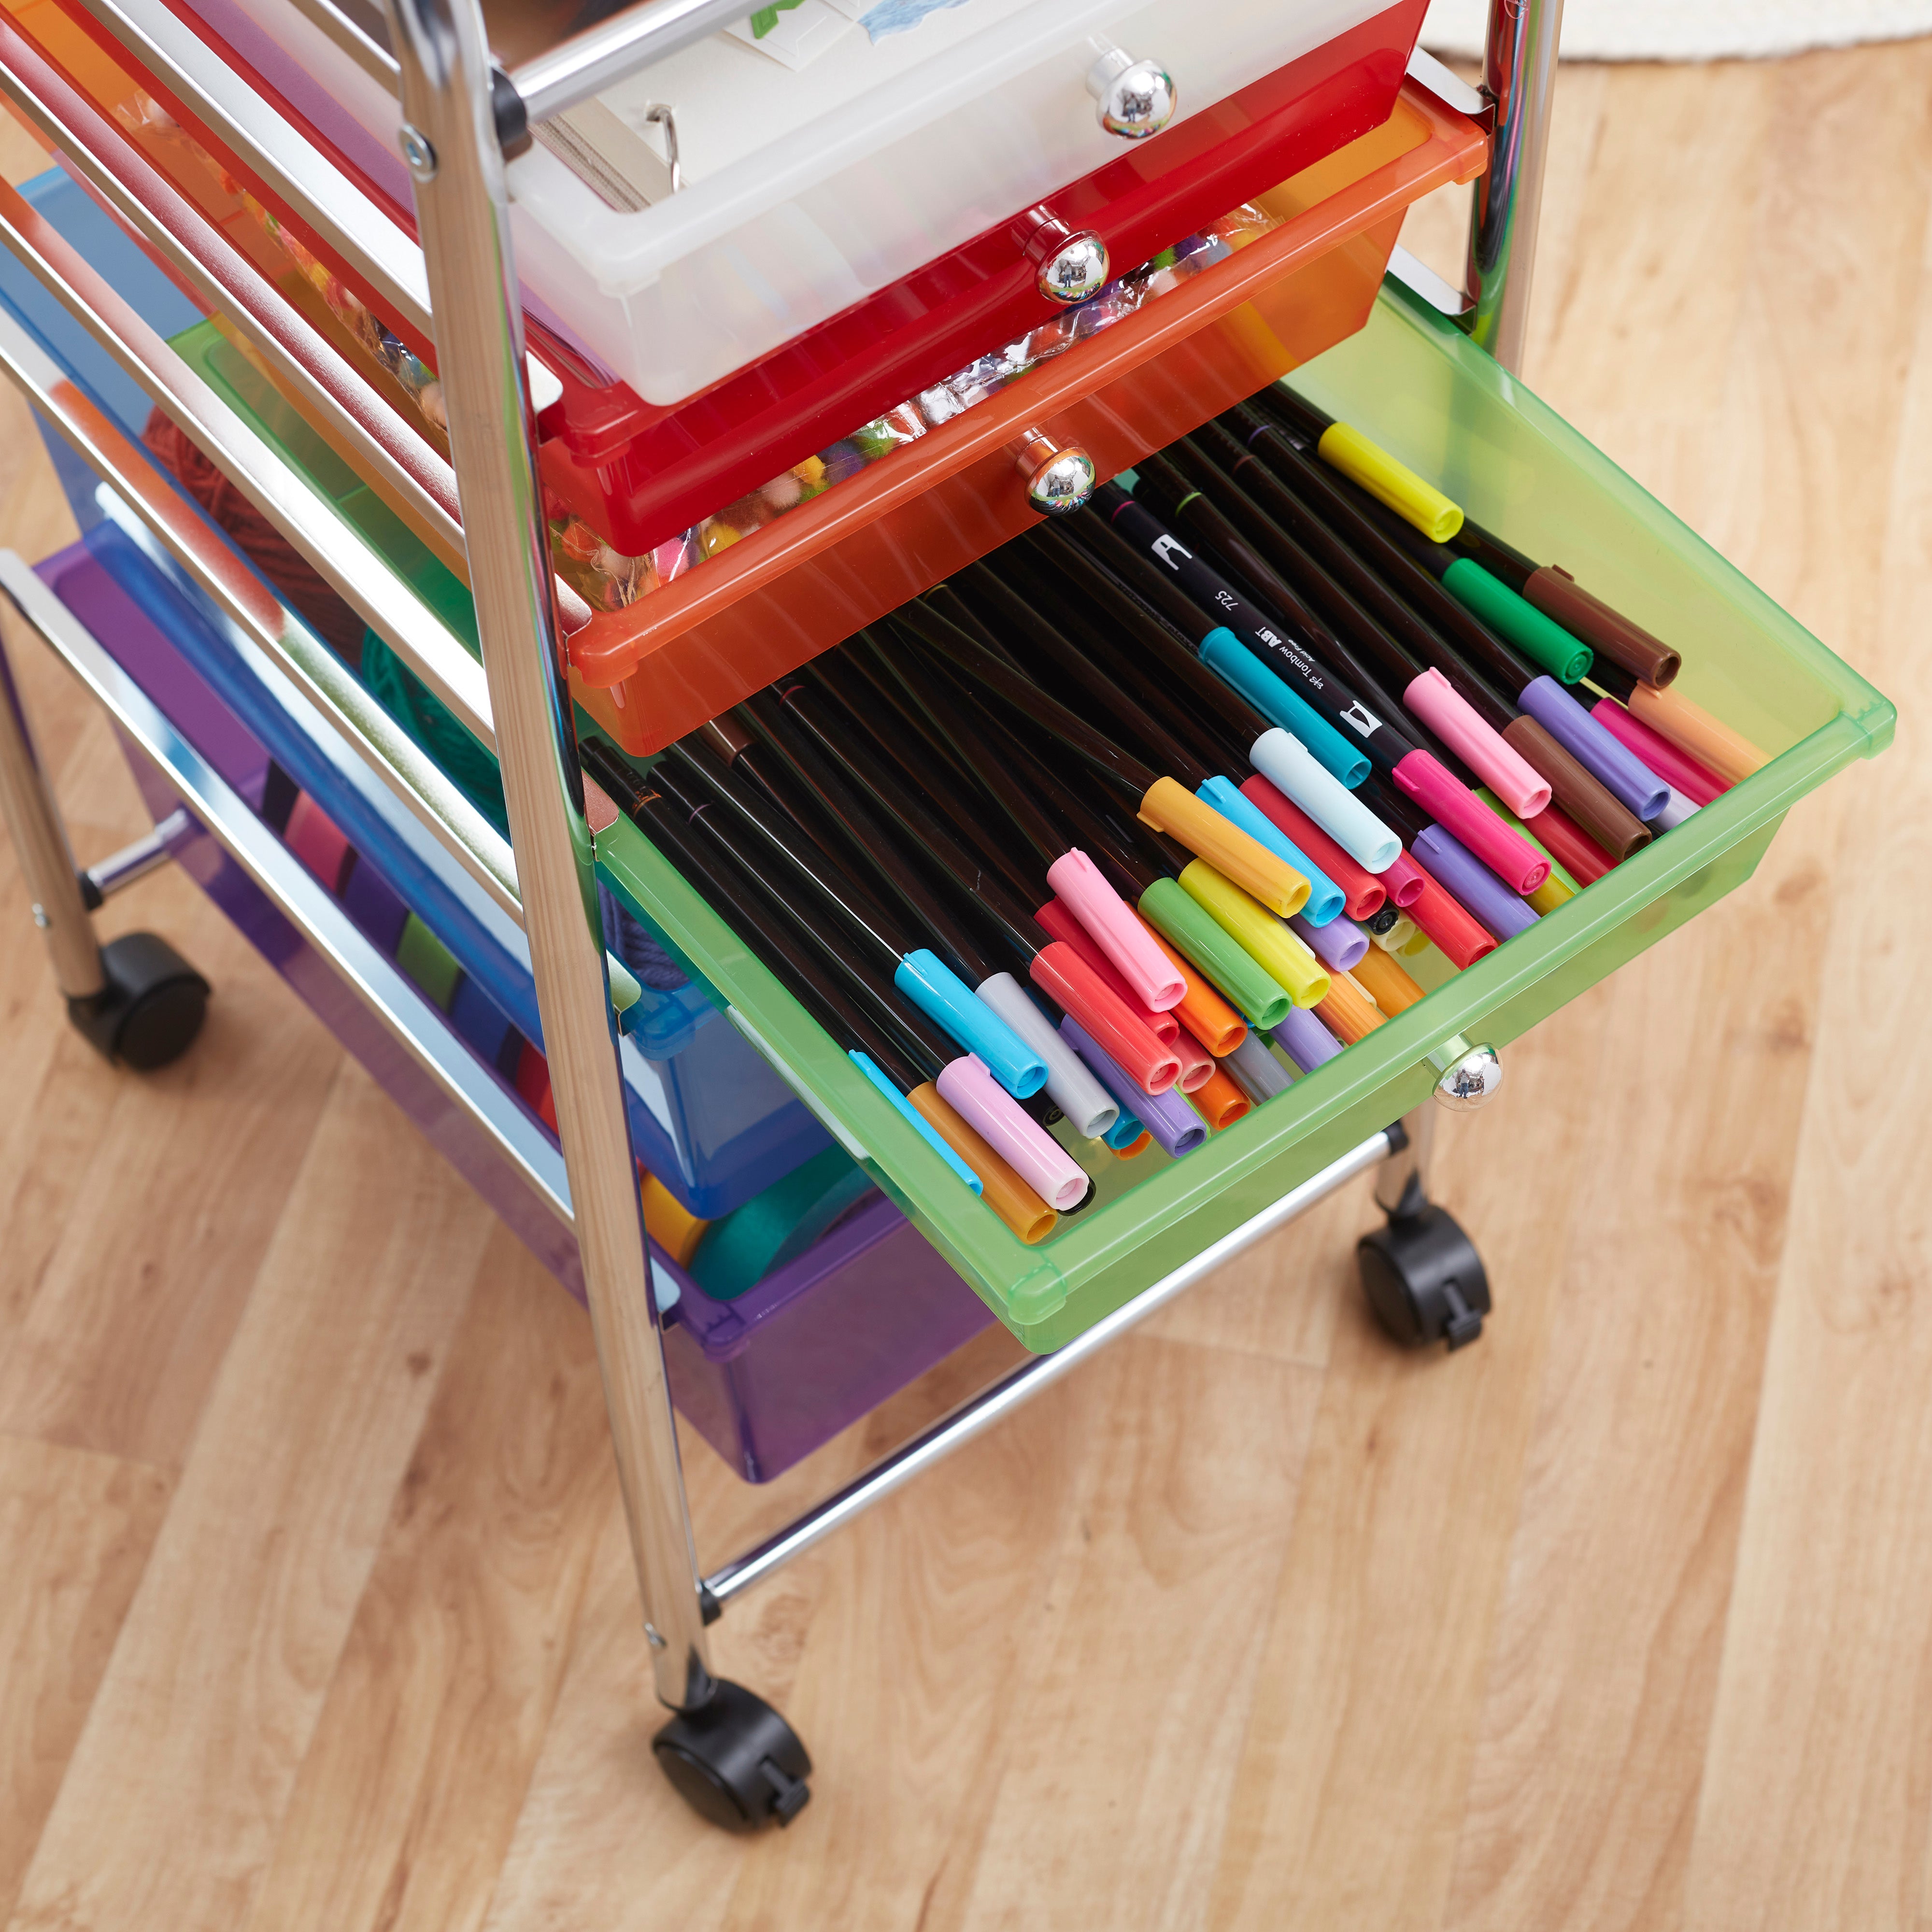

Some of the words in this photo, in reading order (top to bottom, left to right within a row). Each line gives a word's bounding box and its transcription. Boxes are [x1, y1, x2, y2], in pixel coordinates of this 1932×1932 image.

[1215, 591, 1238, 611] 725
[1255, 626, 1282, 648] ABT
[1288, 639, 1302, 651] Free
[1279, 646, 1312, 677] Tombow
[1300, 650, 1315, 662] Acid
